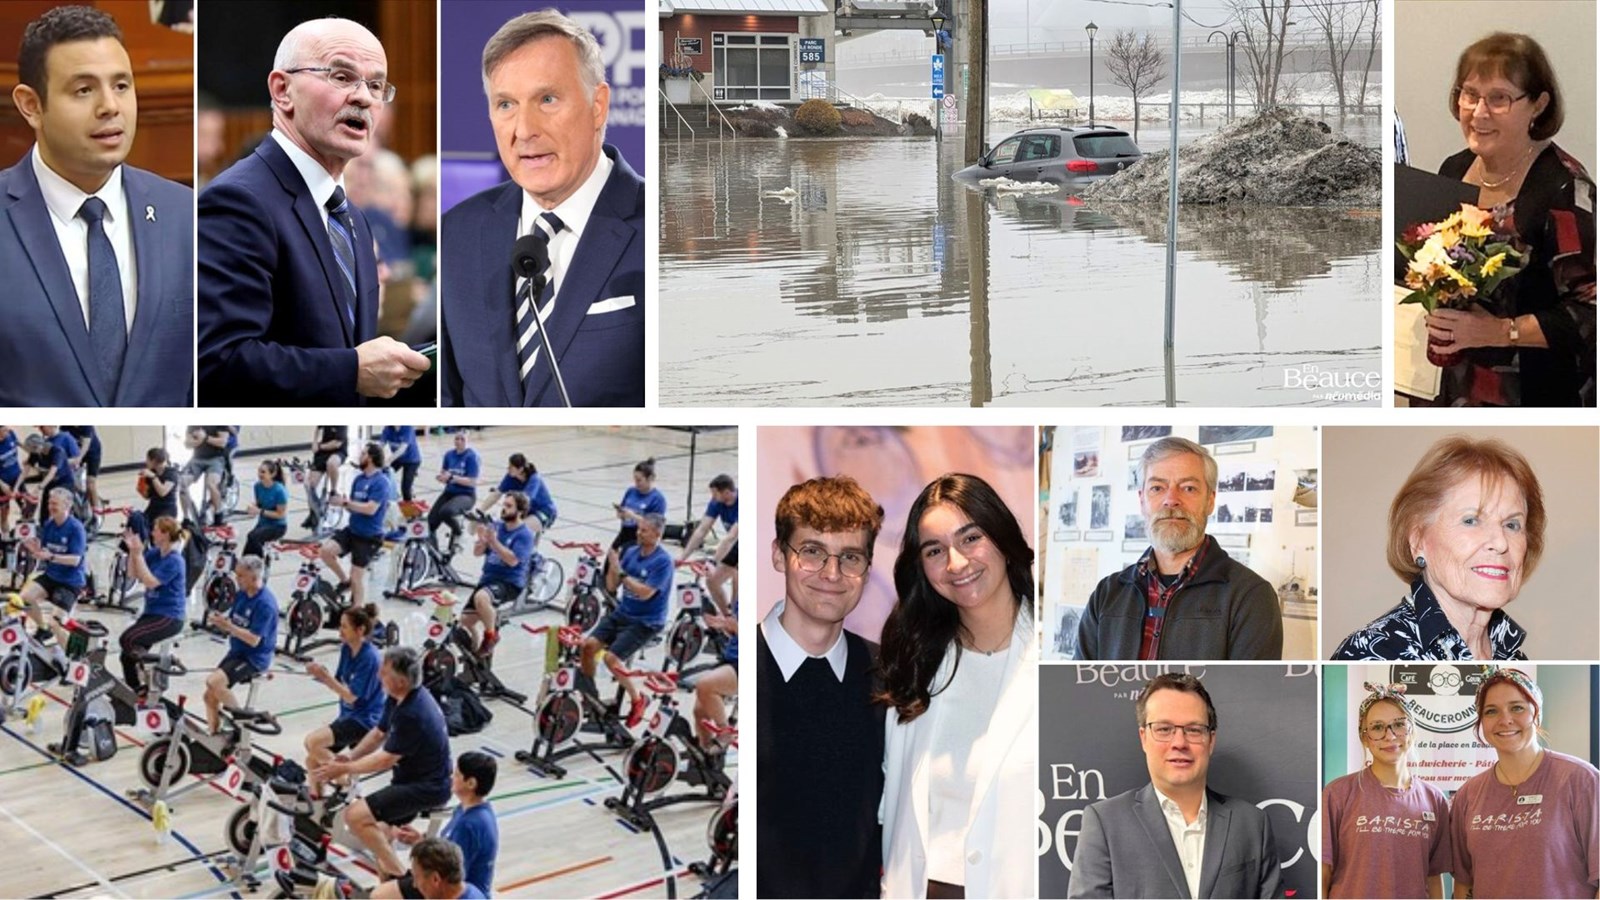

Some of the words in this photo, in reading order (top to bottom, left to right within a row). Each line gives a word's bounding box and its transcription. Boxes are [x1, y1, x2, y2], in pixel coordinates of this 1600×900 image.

[802, 52, 820, 61] 585
[1408, 699, 1477, 724] BEAUCERONN
[1438, 741, 1459, 750] place
[1406, 759, 1467, 768] andwicherie
[1050, 763, 1108, 800] En
[1384, 826, 1406, 835] THERE
